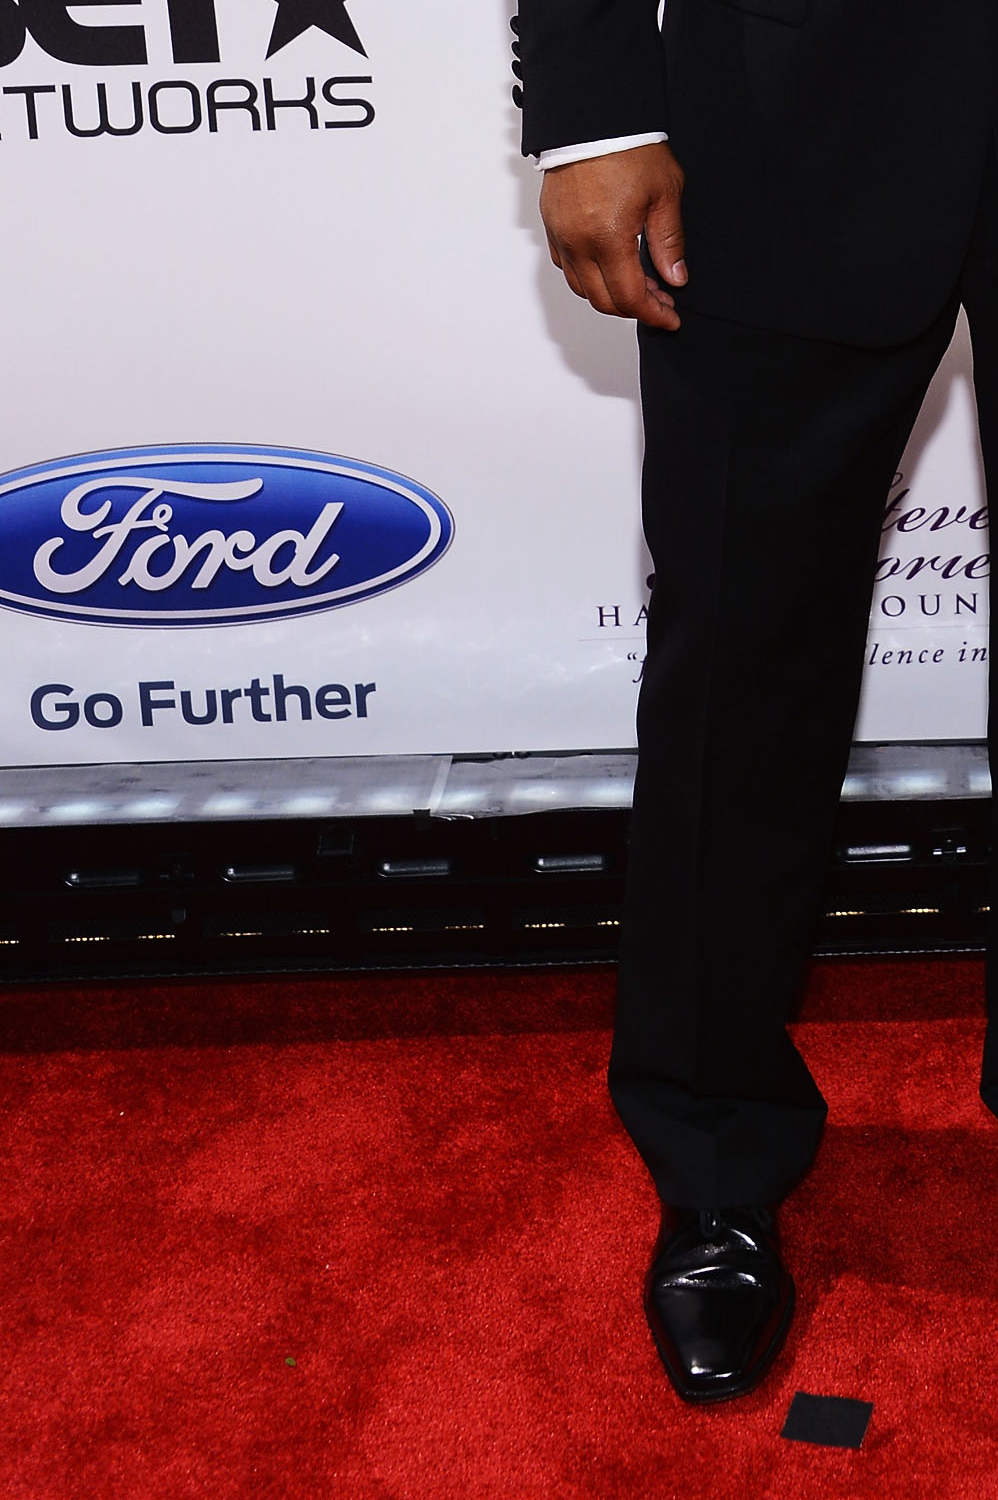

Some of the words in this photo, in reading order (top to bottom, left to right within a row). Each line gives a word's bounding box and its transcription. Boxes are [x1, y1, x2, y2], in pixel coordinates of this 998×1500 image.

[0, 75, 376, 141] TWORKS
[33, 476, 346, 594] Ford
[30, 683, 124, 732] Go
[138, 674, 377, 727] Further
